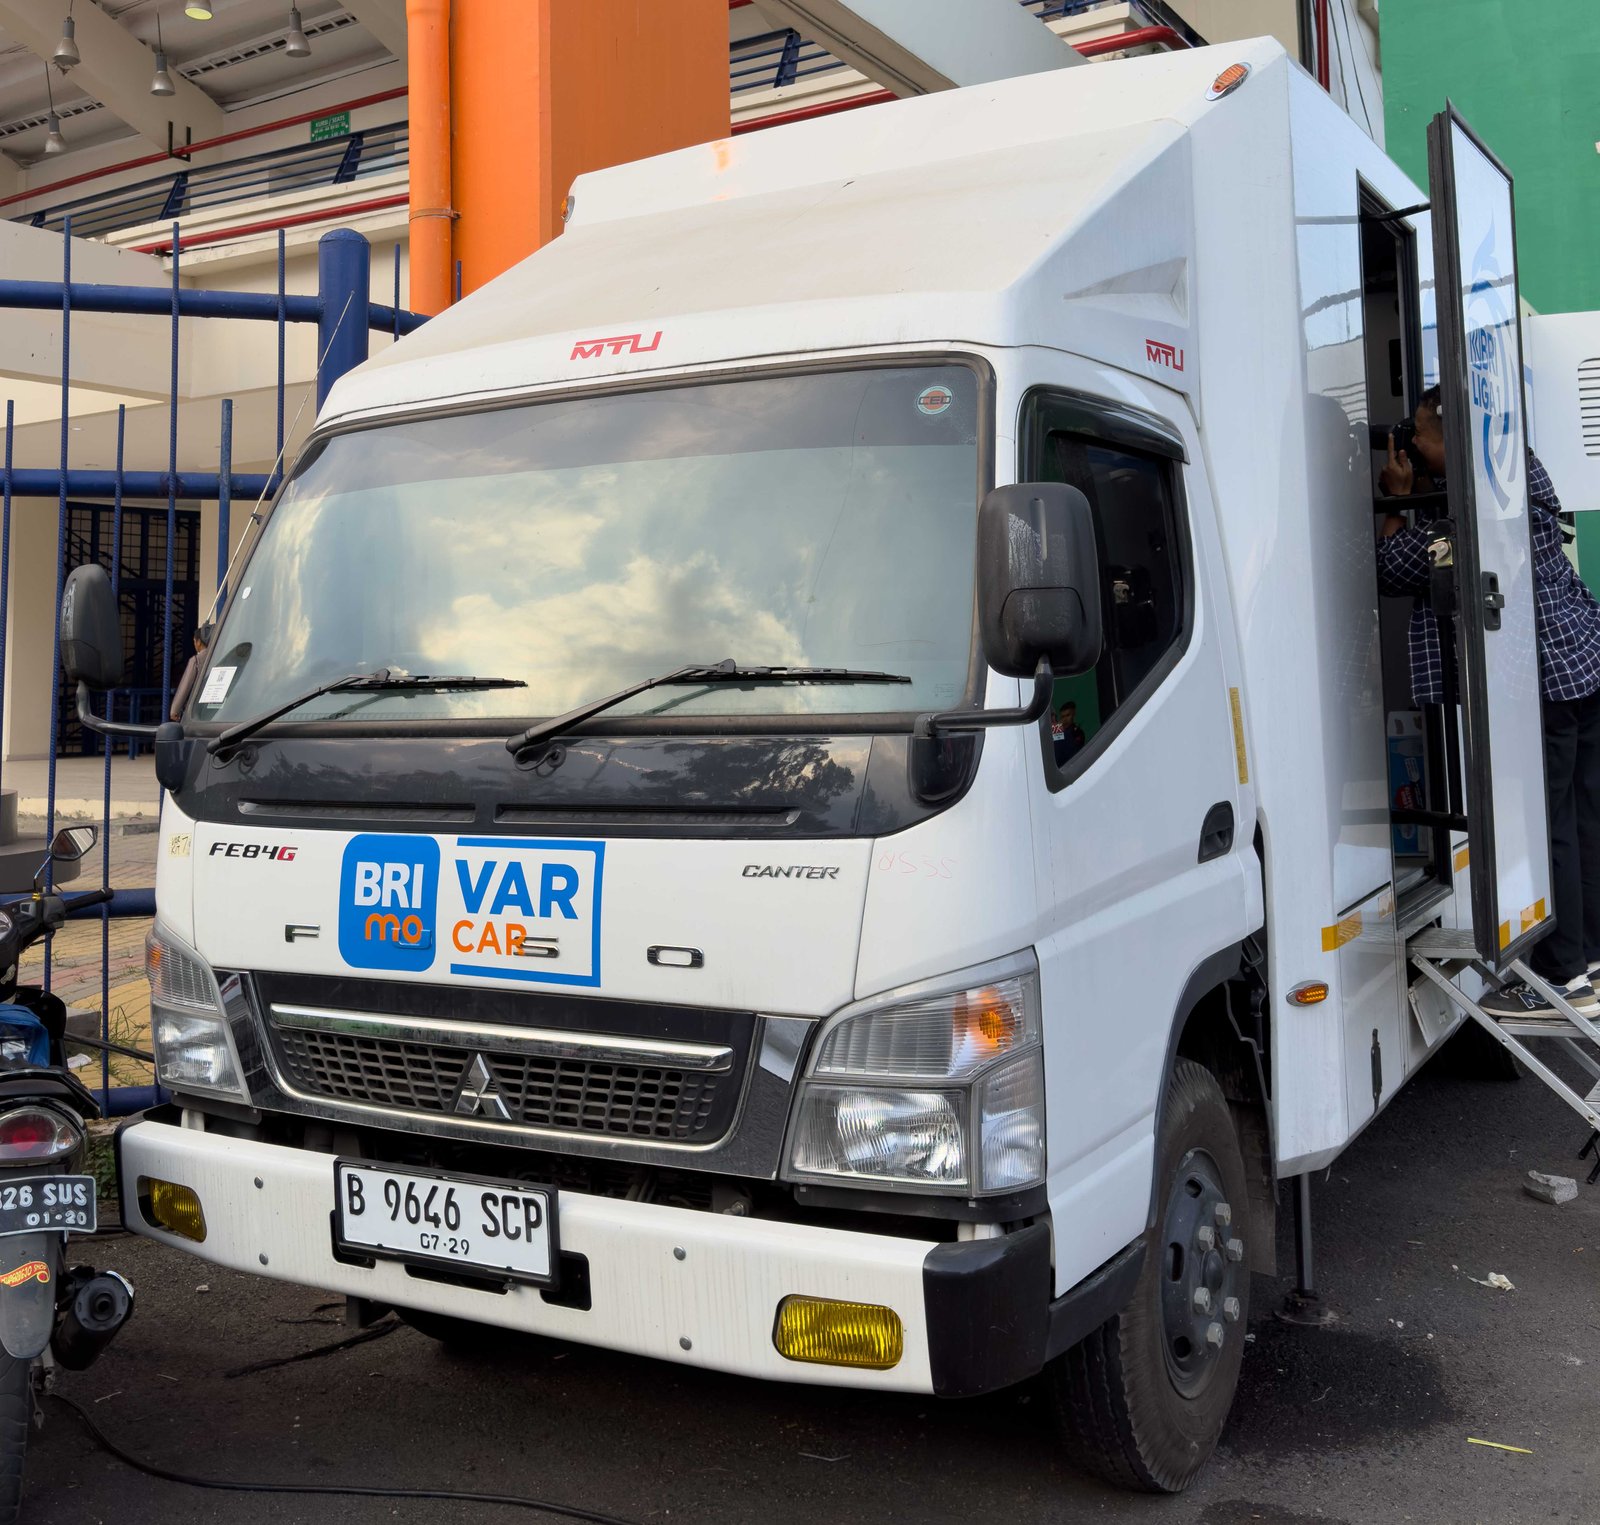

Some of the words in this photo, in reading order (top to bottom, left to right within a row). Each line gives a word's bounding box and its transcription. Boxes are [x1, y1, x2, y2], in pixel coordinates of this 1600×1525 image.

[570, 331, 663, 360] MTU
[1145, 338, 1184, 372] MTU
[208, 842, 298, 861] FE84G
[354, 861, 425, 909] BRI
[742, 864, 840, 880] CANTER
[455, 859, 580, 920] VAR
[365, 913, 423, 944] mo
[452, 919, 529, 957] CAR
[0, 1186, 33, 1210] 26
[43, 1183, 87, 1206] SUS
[347, 1173, 366, 1216] B
[384, 1178, 461, 1231] 9646
[481, 1192, 543, 1243] SCP
